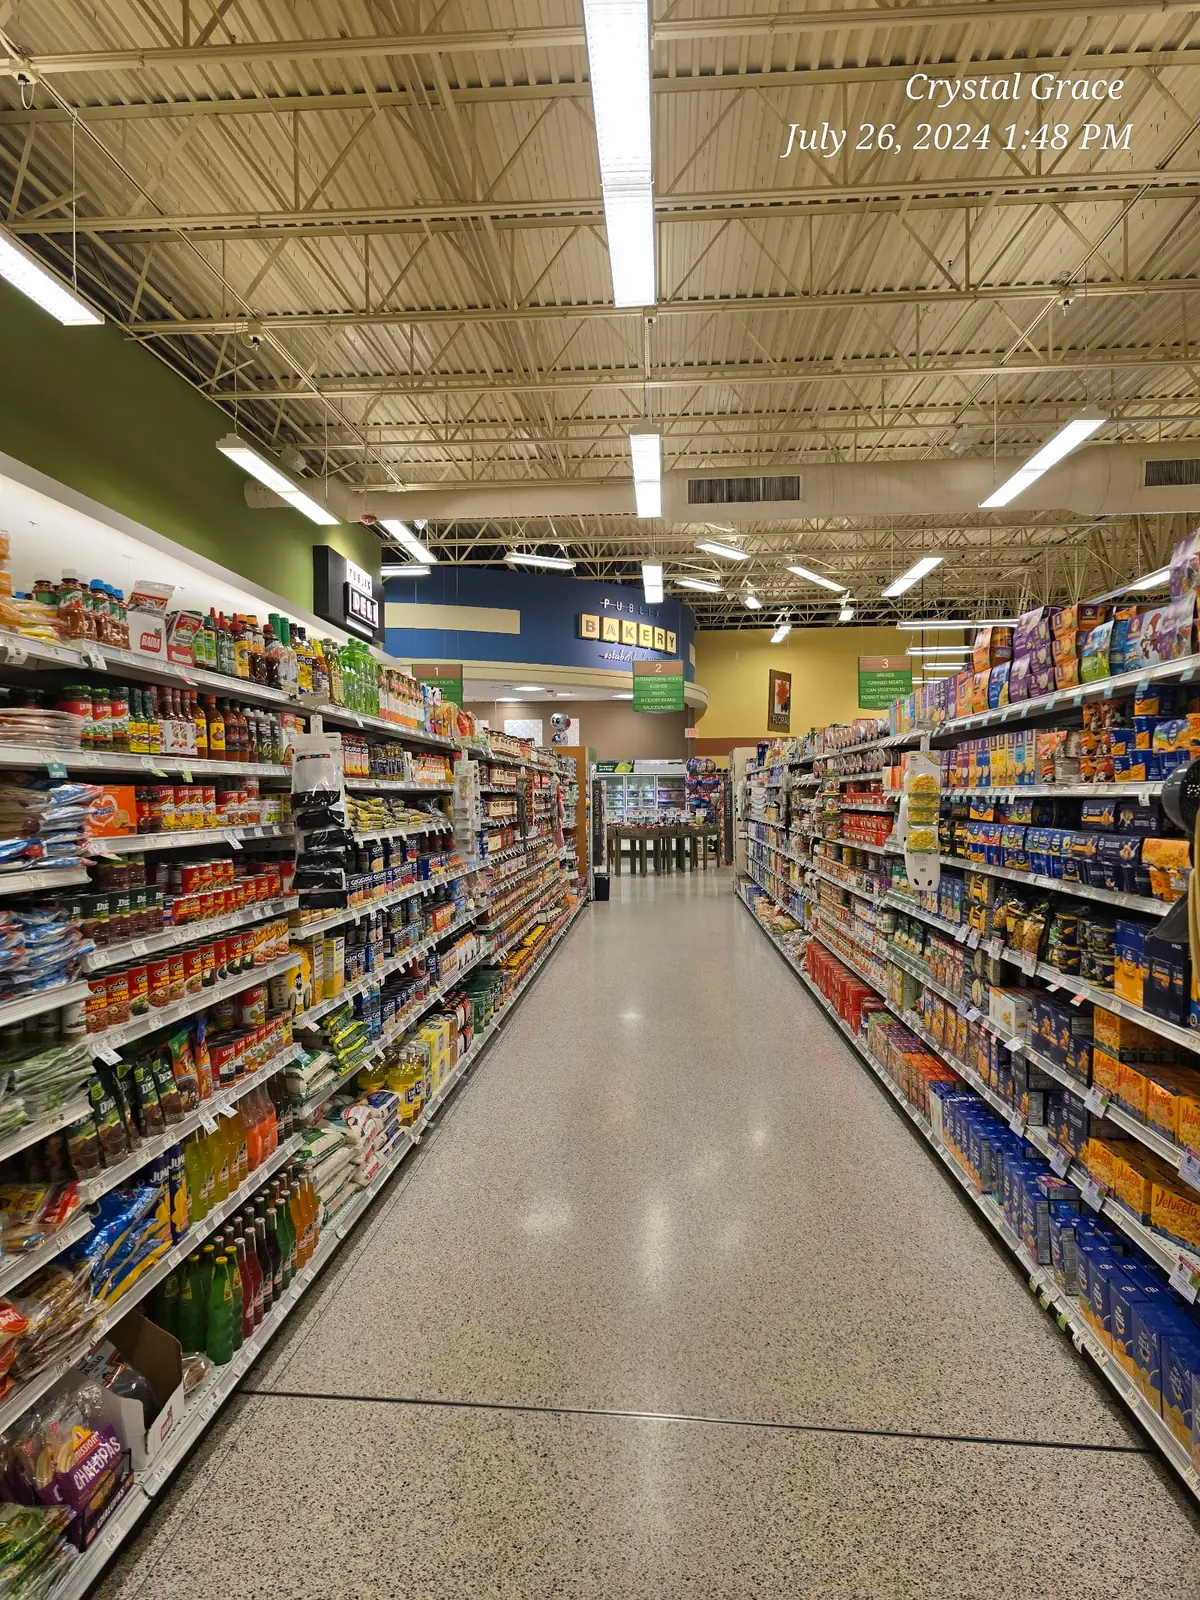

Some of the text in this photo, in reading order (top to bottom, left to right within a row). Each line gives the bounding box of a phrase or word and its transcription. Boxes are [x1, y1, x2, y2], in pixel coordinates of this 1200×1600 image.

[348, 567, 371, 591] PUBLIX
[352, 590, 378, 625] DELI
[603, 598, 660, 620] PUBLIX
[585, 619, 676, 649] BAKERY
[434, 666, 439, 677] 1
[655, 663, 662, 673] 2
[882, 658, 889, 669] 3
[1155, 1189, 1198, 1217] Velveeta
[73, 1436, 121, 1491] CHALUPAS
[96, 1487, 125, 1529] CHALUPAS
